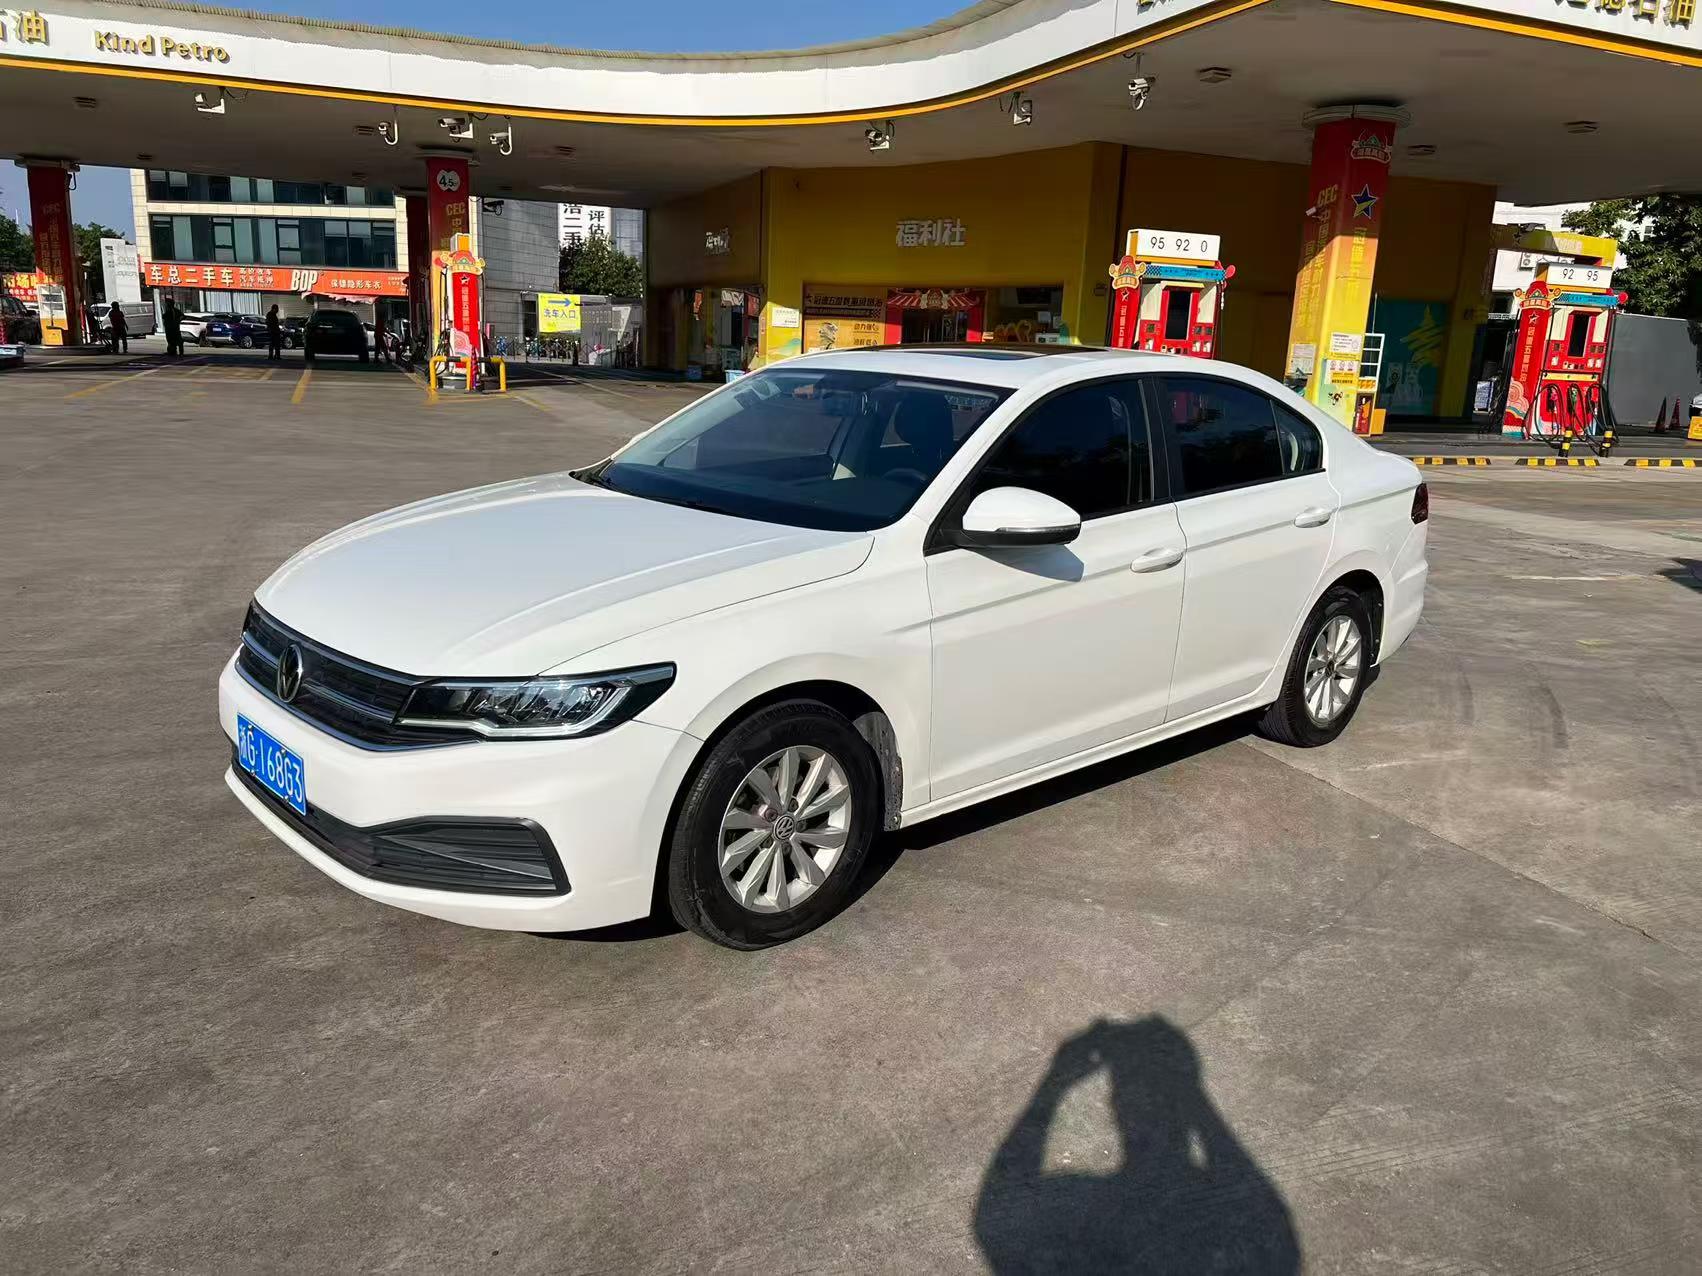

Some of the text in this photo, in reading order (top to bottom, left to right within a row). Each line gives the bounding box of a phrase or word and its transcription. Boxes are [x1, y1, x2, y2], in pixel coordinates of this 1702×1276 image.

[0, 9, 48, 44] 油
[94, 30, 229, 63] Kind Petro
[588, 210, 606, 235] 评估
[895, 218, 967, 248] 福利社
[1150, 236, 1208, 253] 95 92 0
[150, 265, 234, 286] 车总二手车
[1562, 268, 1599, 281] 92 95
[543, 308, 576, 318] 洗车入口
